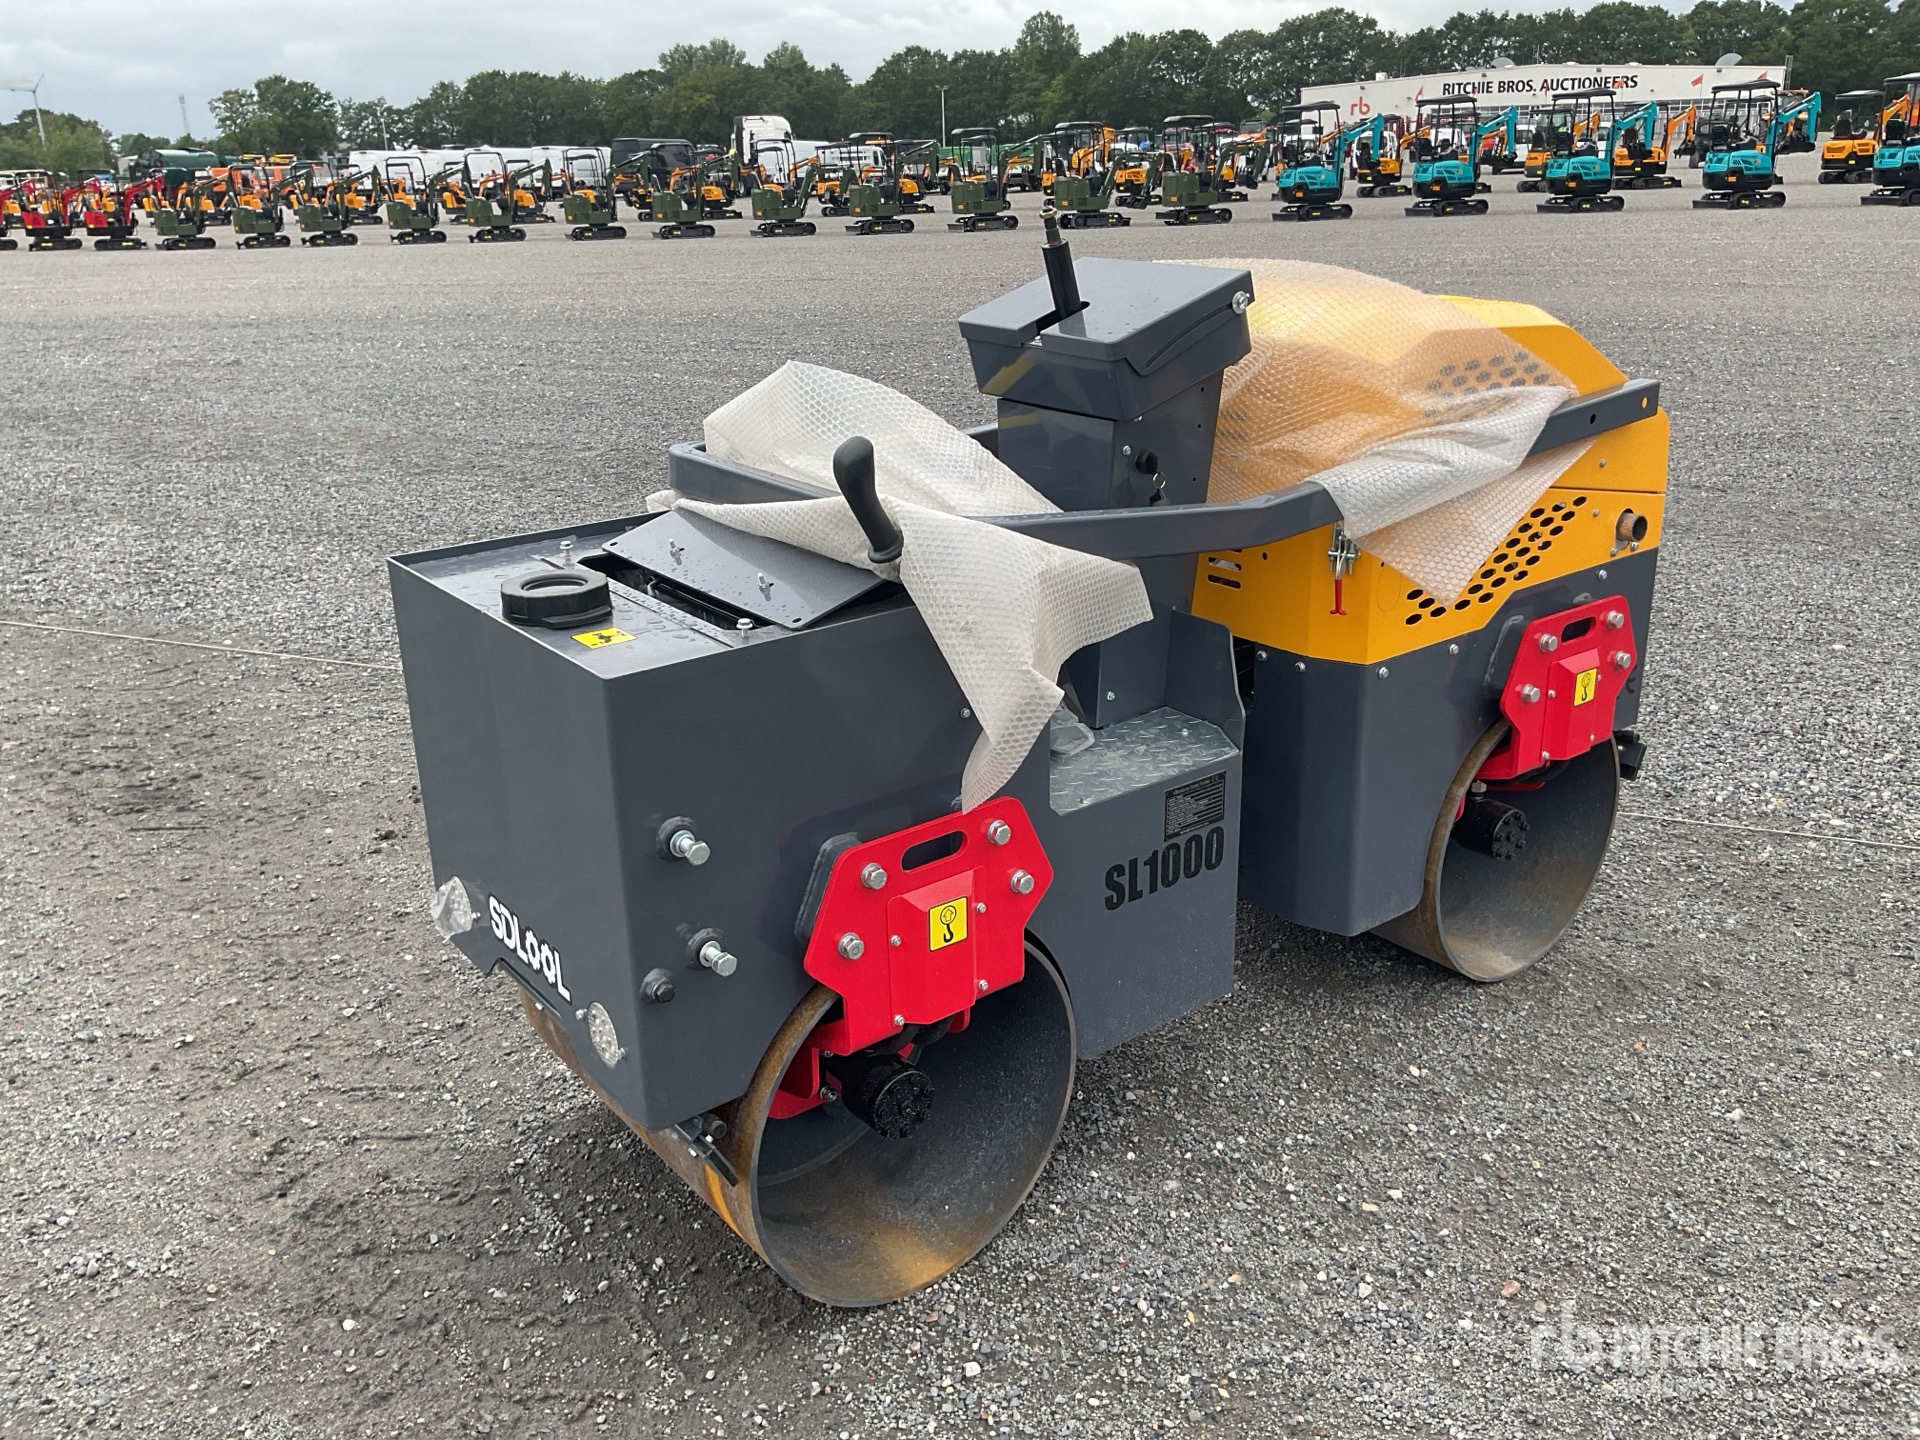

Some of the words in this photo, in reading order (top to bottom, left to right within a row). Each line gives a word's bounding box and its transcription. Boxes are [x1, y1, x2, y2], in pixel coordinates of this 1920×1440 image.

[1442, 81, 1494, 96] RITCHIE
[1497, 79, 1537, 93] BROS.
[1540, 75, 1638, 91] AUCTIONEERS
[1350, 97, 1371, 116] rb
[1104, 826, 1225, 911] SL1000
